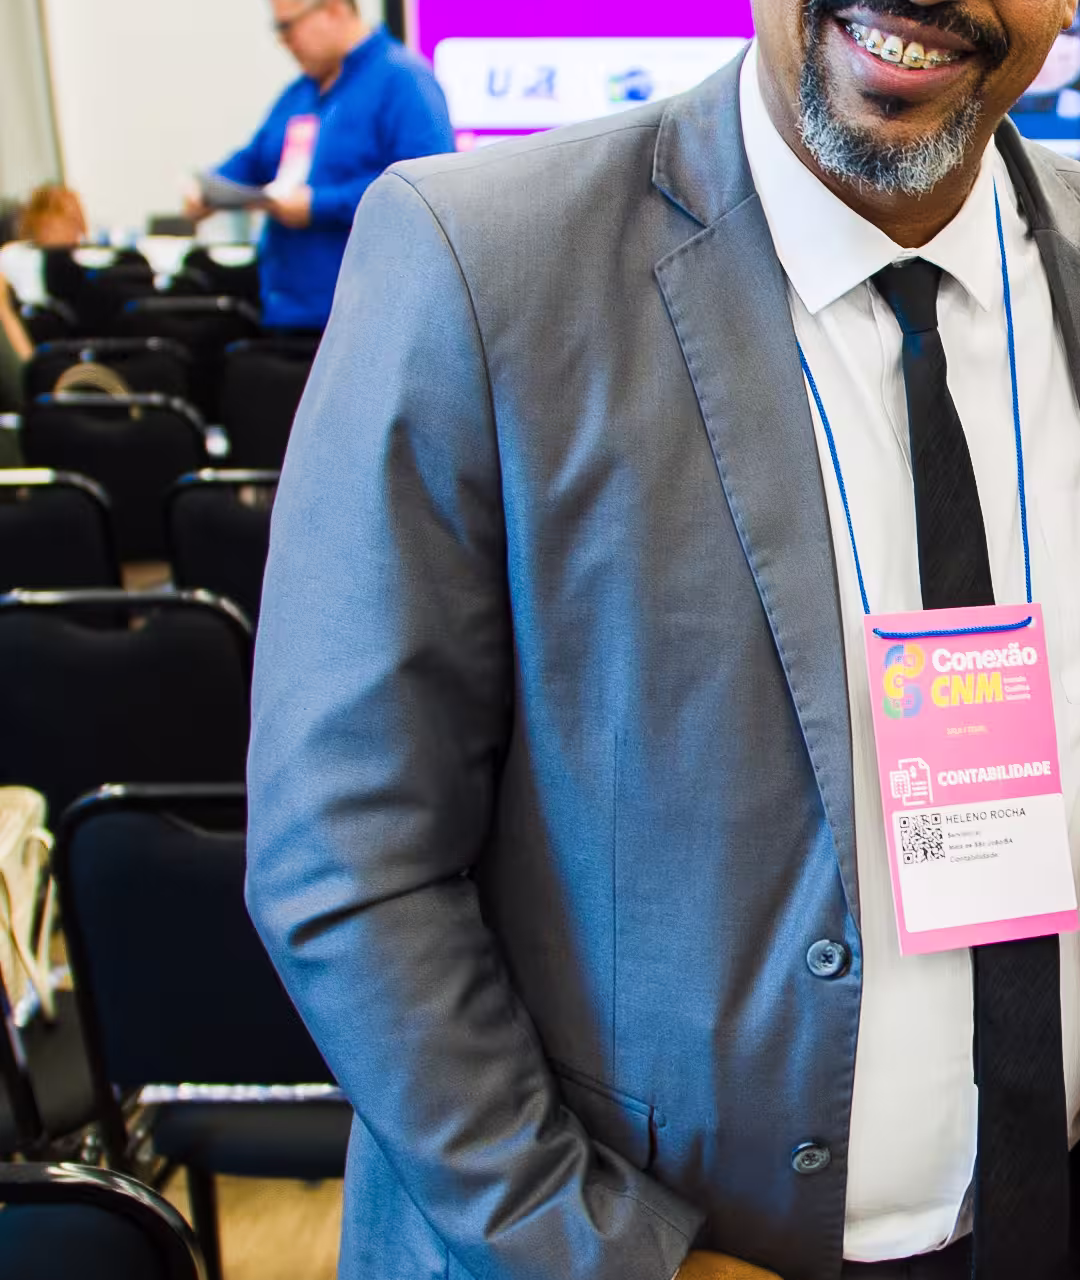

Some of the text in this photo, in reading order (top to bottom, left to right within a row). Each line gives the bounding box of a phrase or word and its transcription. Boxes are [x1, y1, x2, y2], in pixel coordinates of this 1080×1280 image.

[931, 642, 1038, 672] Conexão
[931, 672, 1004, 708] CNM
[937, 760, 1052, 787] CONTABILIDADE
[946, 807, 1027, 825] HELENO ROCHA
